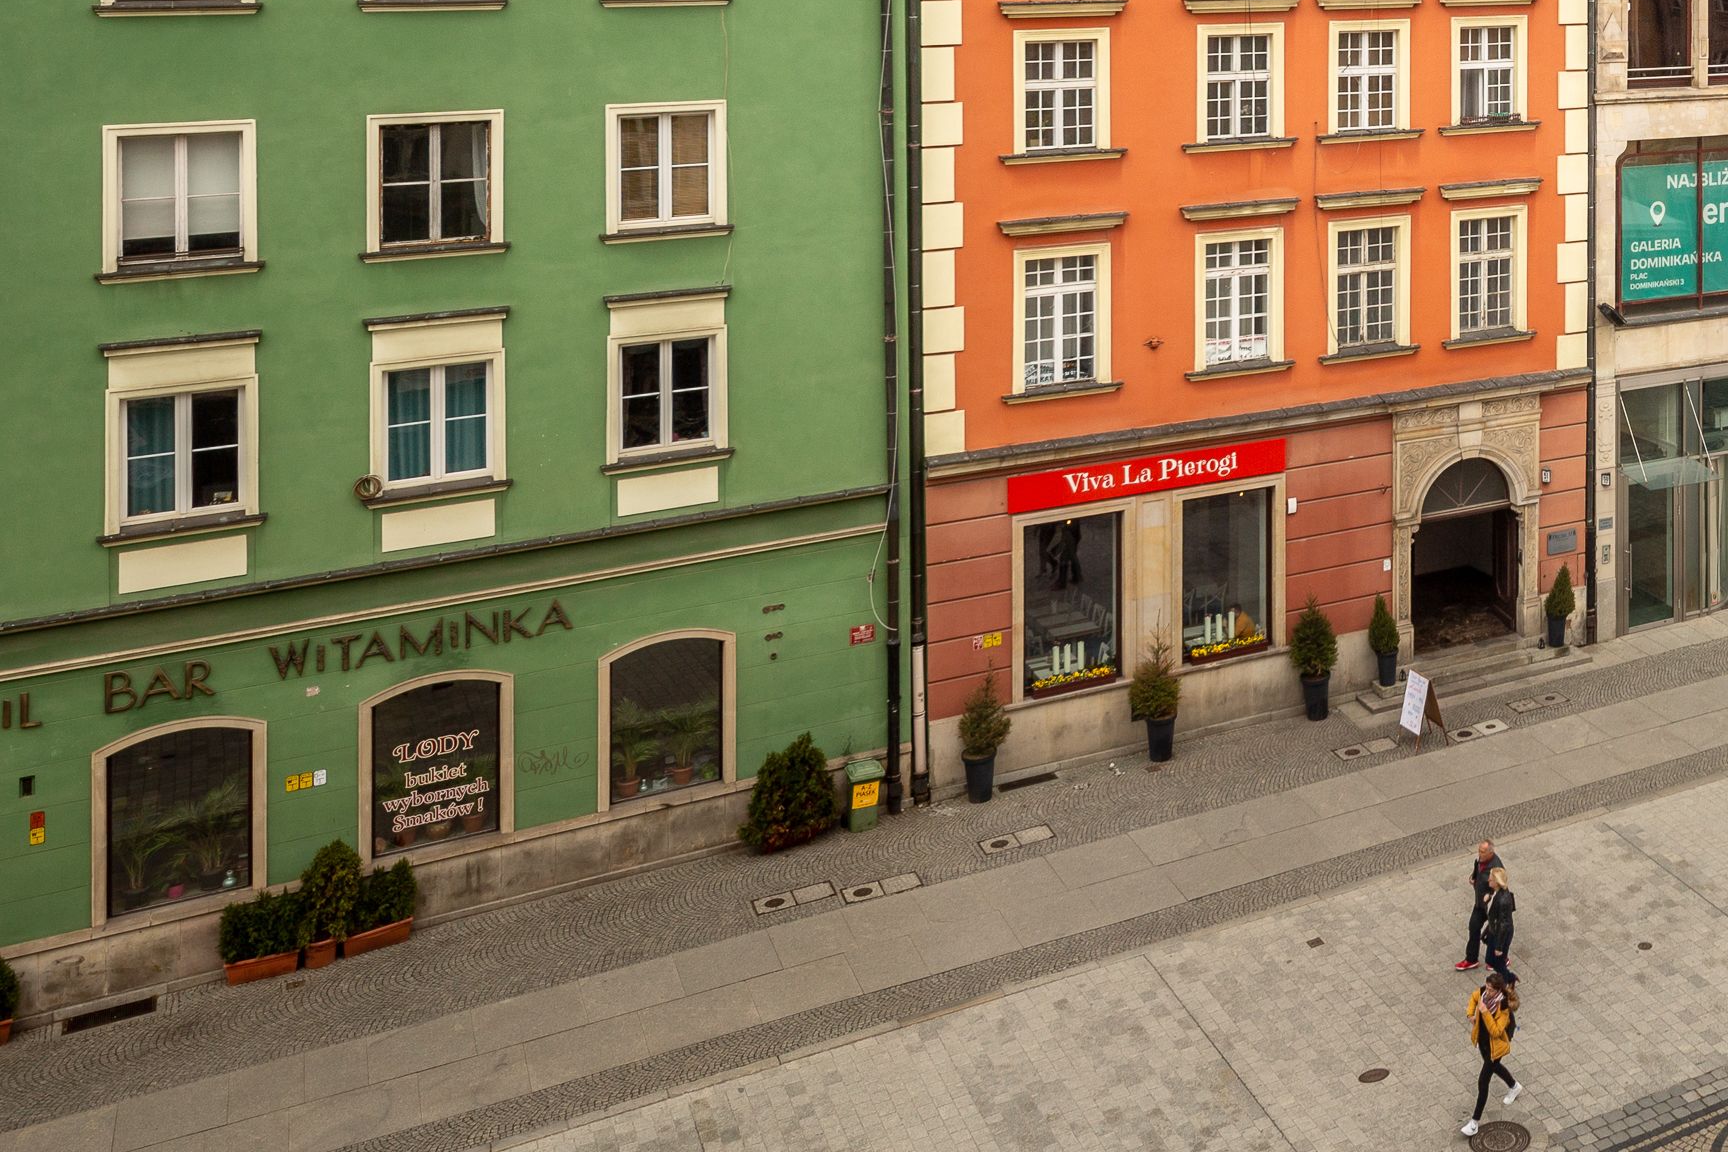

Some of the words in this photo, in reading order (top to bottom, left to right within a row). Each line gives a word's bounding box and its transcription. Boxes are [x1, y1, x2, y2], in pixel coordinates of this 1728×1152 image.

[1630, 237, 1681, 253] GALERIA
[1629, 278, 1680, 290] DOMINIKAŃSKI
[1680, 278, 1685, 286] 3
[1630, 272, 1648, 280] PLAC
[1062, 472, 1115, 494] Viva
[1121, 464, 1153, 486] La
[1157, 452, 1238, 482] Pierogi
[104, 660, 215, 715] BAR
[269, 598, 575, 681] WITAMINKA
[392, 729, 480, 764] LODY
[404, 762, 467, 789] bukiet
[382, 776, 490, 814] wybornych
[392, 799, 475, 833] Smaków
